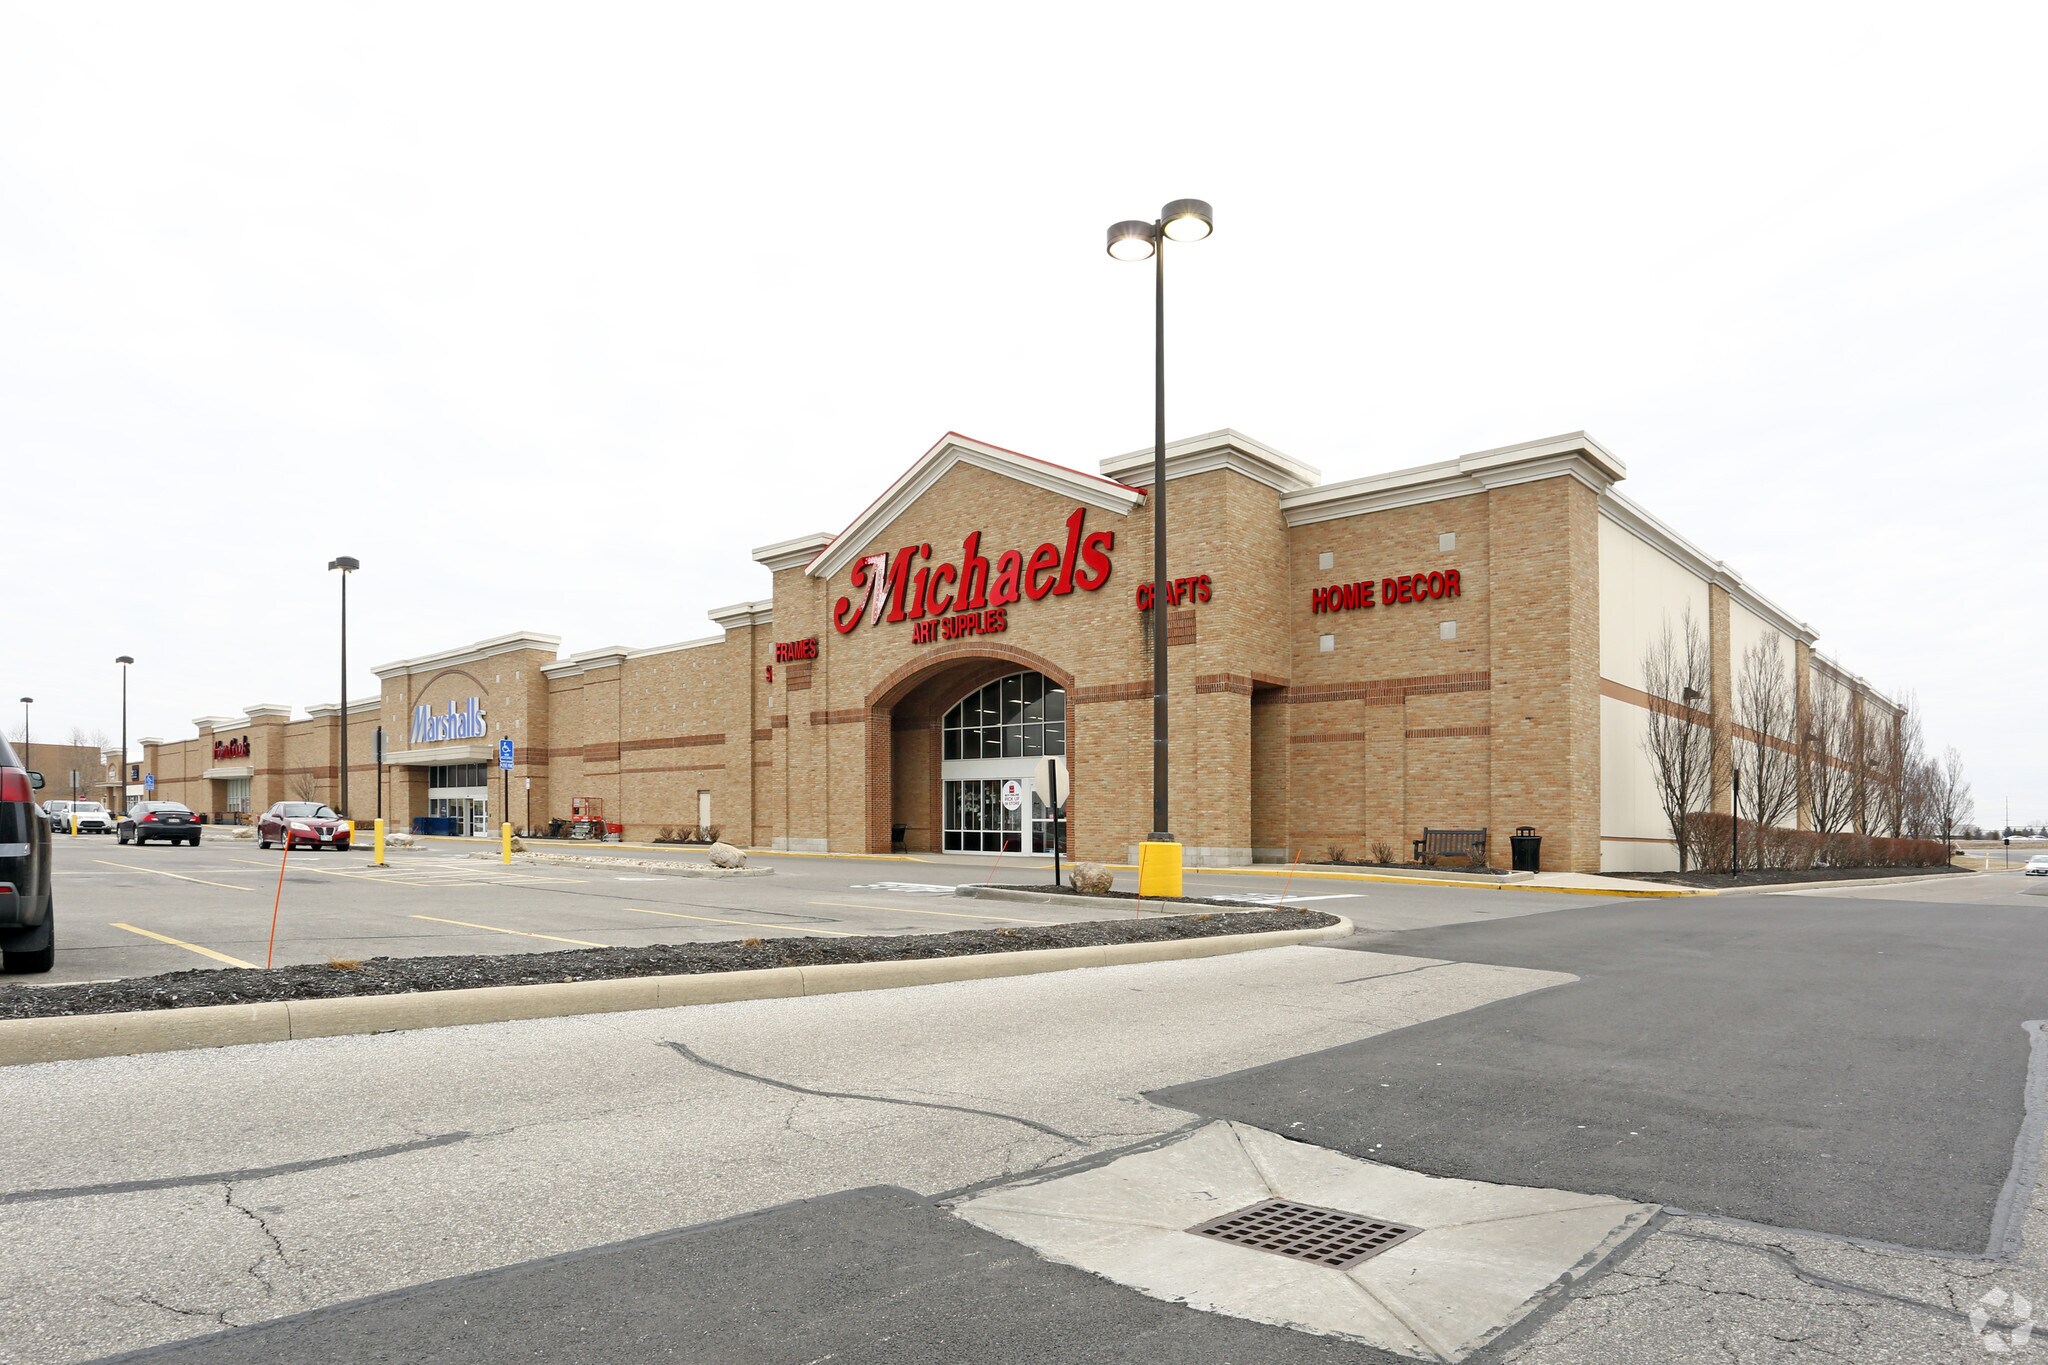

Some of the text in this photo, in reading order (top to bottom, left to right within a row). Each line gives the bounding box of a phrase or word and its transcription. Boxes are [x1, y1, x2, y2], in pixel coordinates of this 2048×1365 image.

[834, 507, 1115, 634] Michaels
[1312, 568, 1461, 614] HOME DECOR
[911, 607, 1008, 645] ART SUPPLIES
[775, 636, 819, 663] FRAMES
[410, 697, 487, 743] Marshalls
